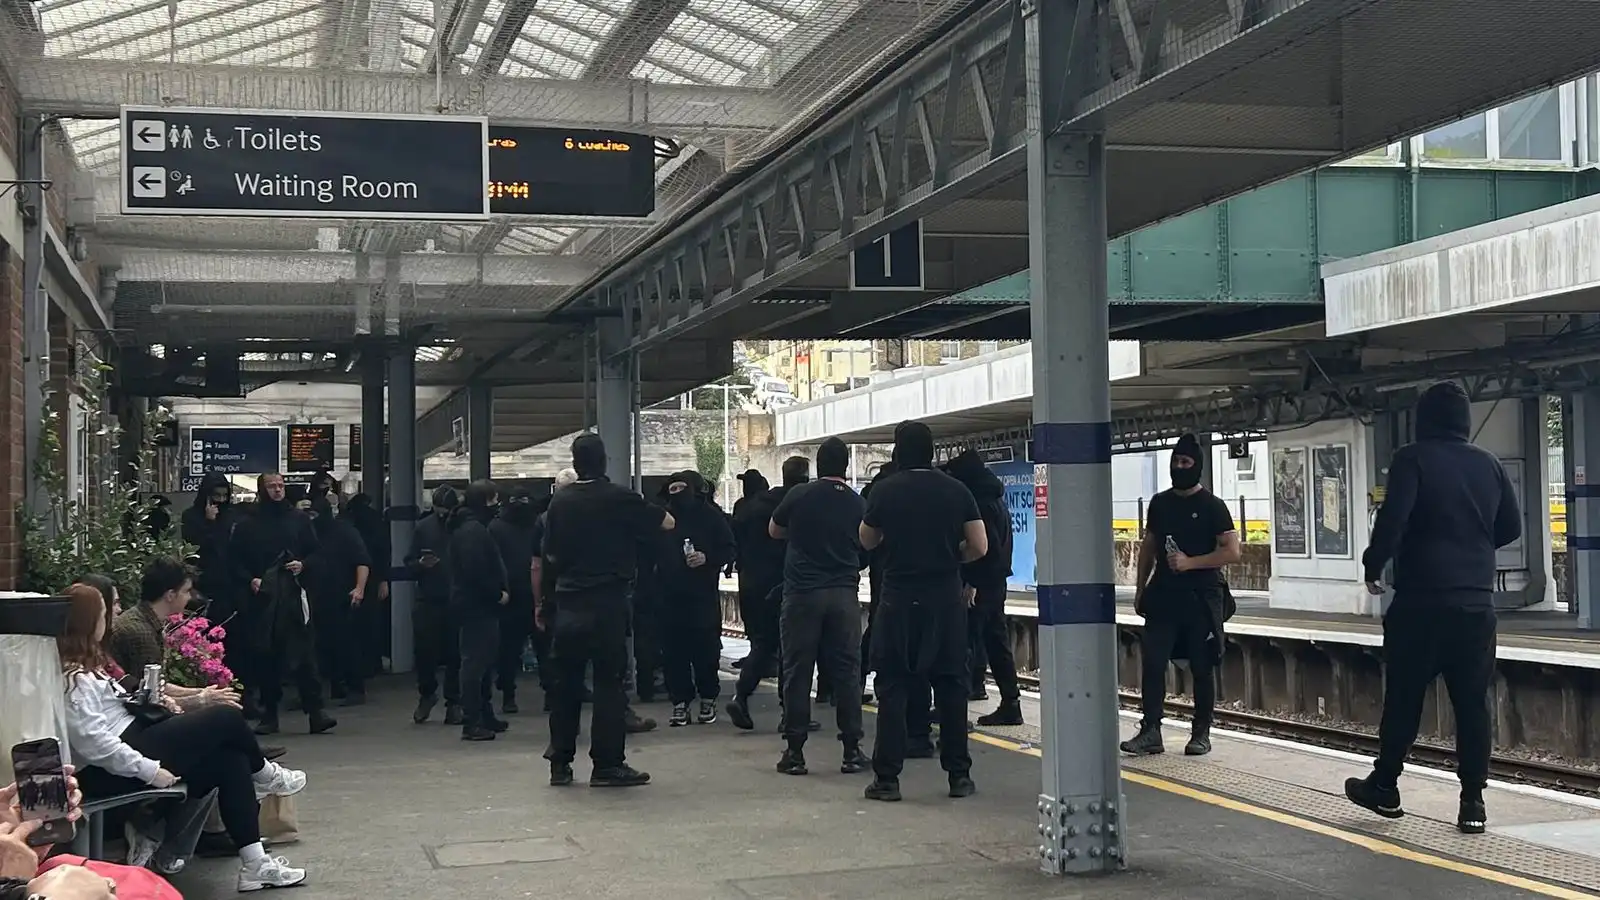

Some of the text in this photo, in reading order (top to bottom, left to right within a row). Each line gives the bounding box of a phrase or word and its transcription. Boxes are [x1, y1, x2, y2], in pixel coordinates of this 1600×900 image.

[234, 127, 322, 151] Toilets
[234, 173, 418, 203] Waiting Room
[872, 233, 892, 277] 1
[1235, 442, 1245, 456] 3
[214, 465, 227, 473] Way
